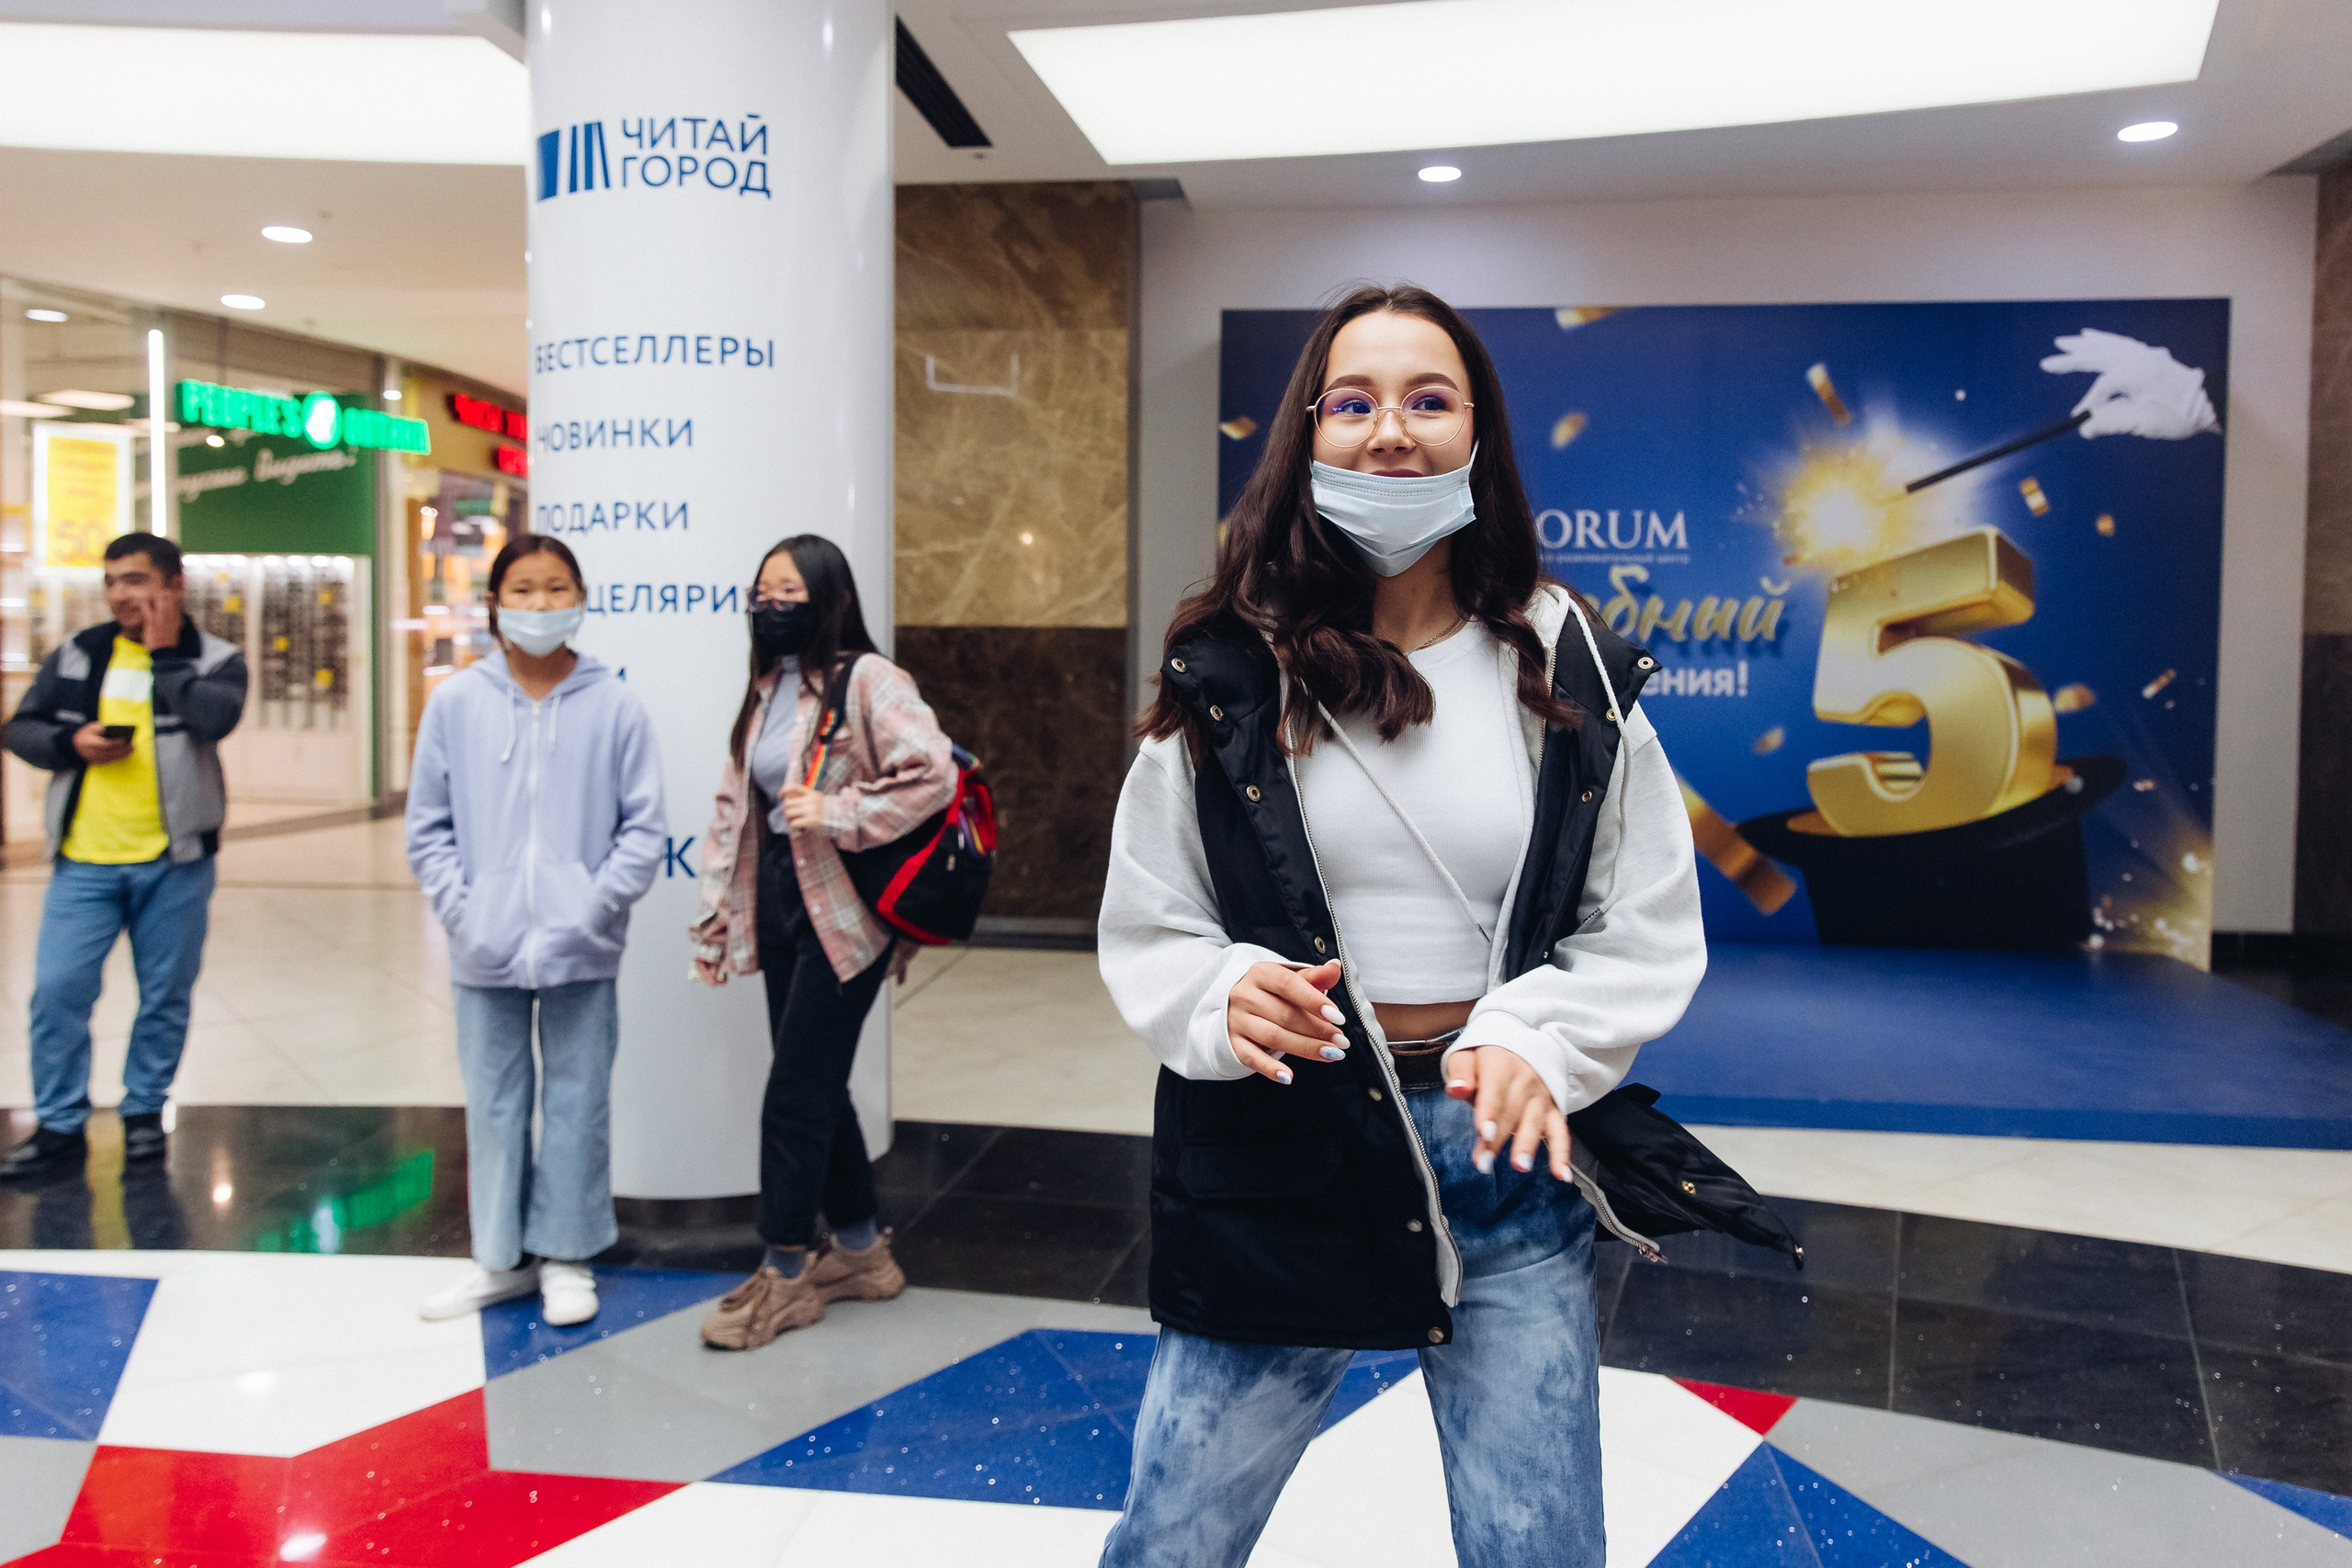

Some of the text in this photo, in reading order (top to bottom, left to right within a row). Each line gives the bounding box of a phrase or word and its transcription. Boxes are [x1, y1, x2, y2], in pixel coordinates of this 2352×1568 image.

[621, 113, 768, 155] ЧИТАЙ
[622, 154, 772, 198] ГОРОД
[536, 335, 774, 373] БЕСТСЕЛЛЕРЫ
[536, 418, 694, 456] НОВИНКИ
[536, 502, 689, 533] ПОДАРКИ
[1534, 508, 1689, 549] ORUM
[586, 583, 748, 616] ЦЕЛЯРИ
[1582, 565, 1791, 642] бный
[1640, 660, 1749, 697] ения!
[1806, 524, 2057, 838] 5
